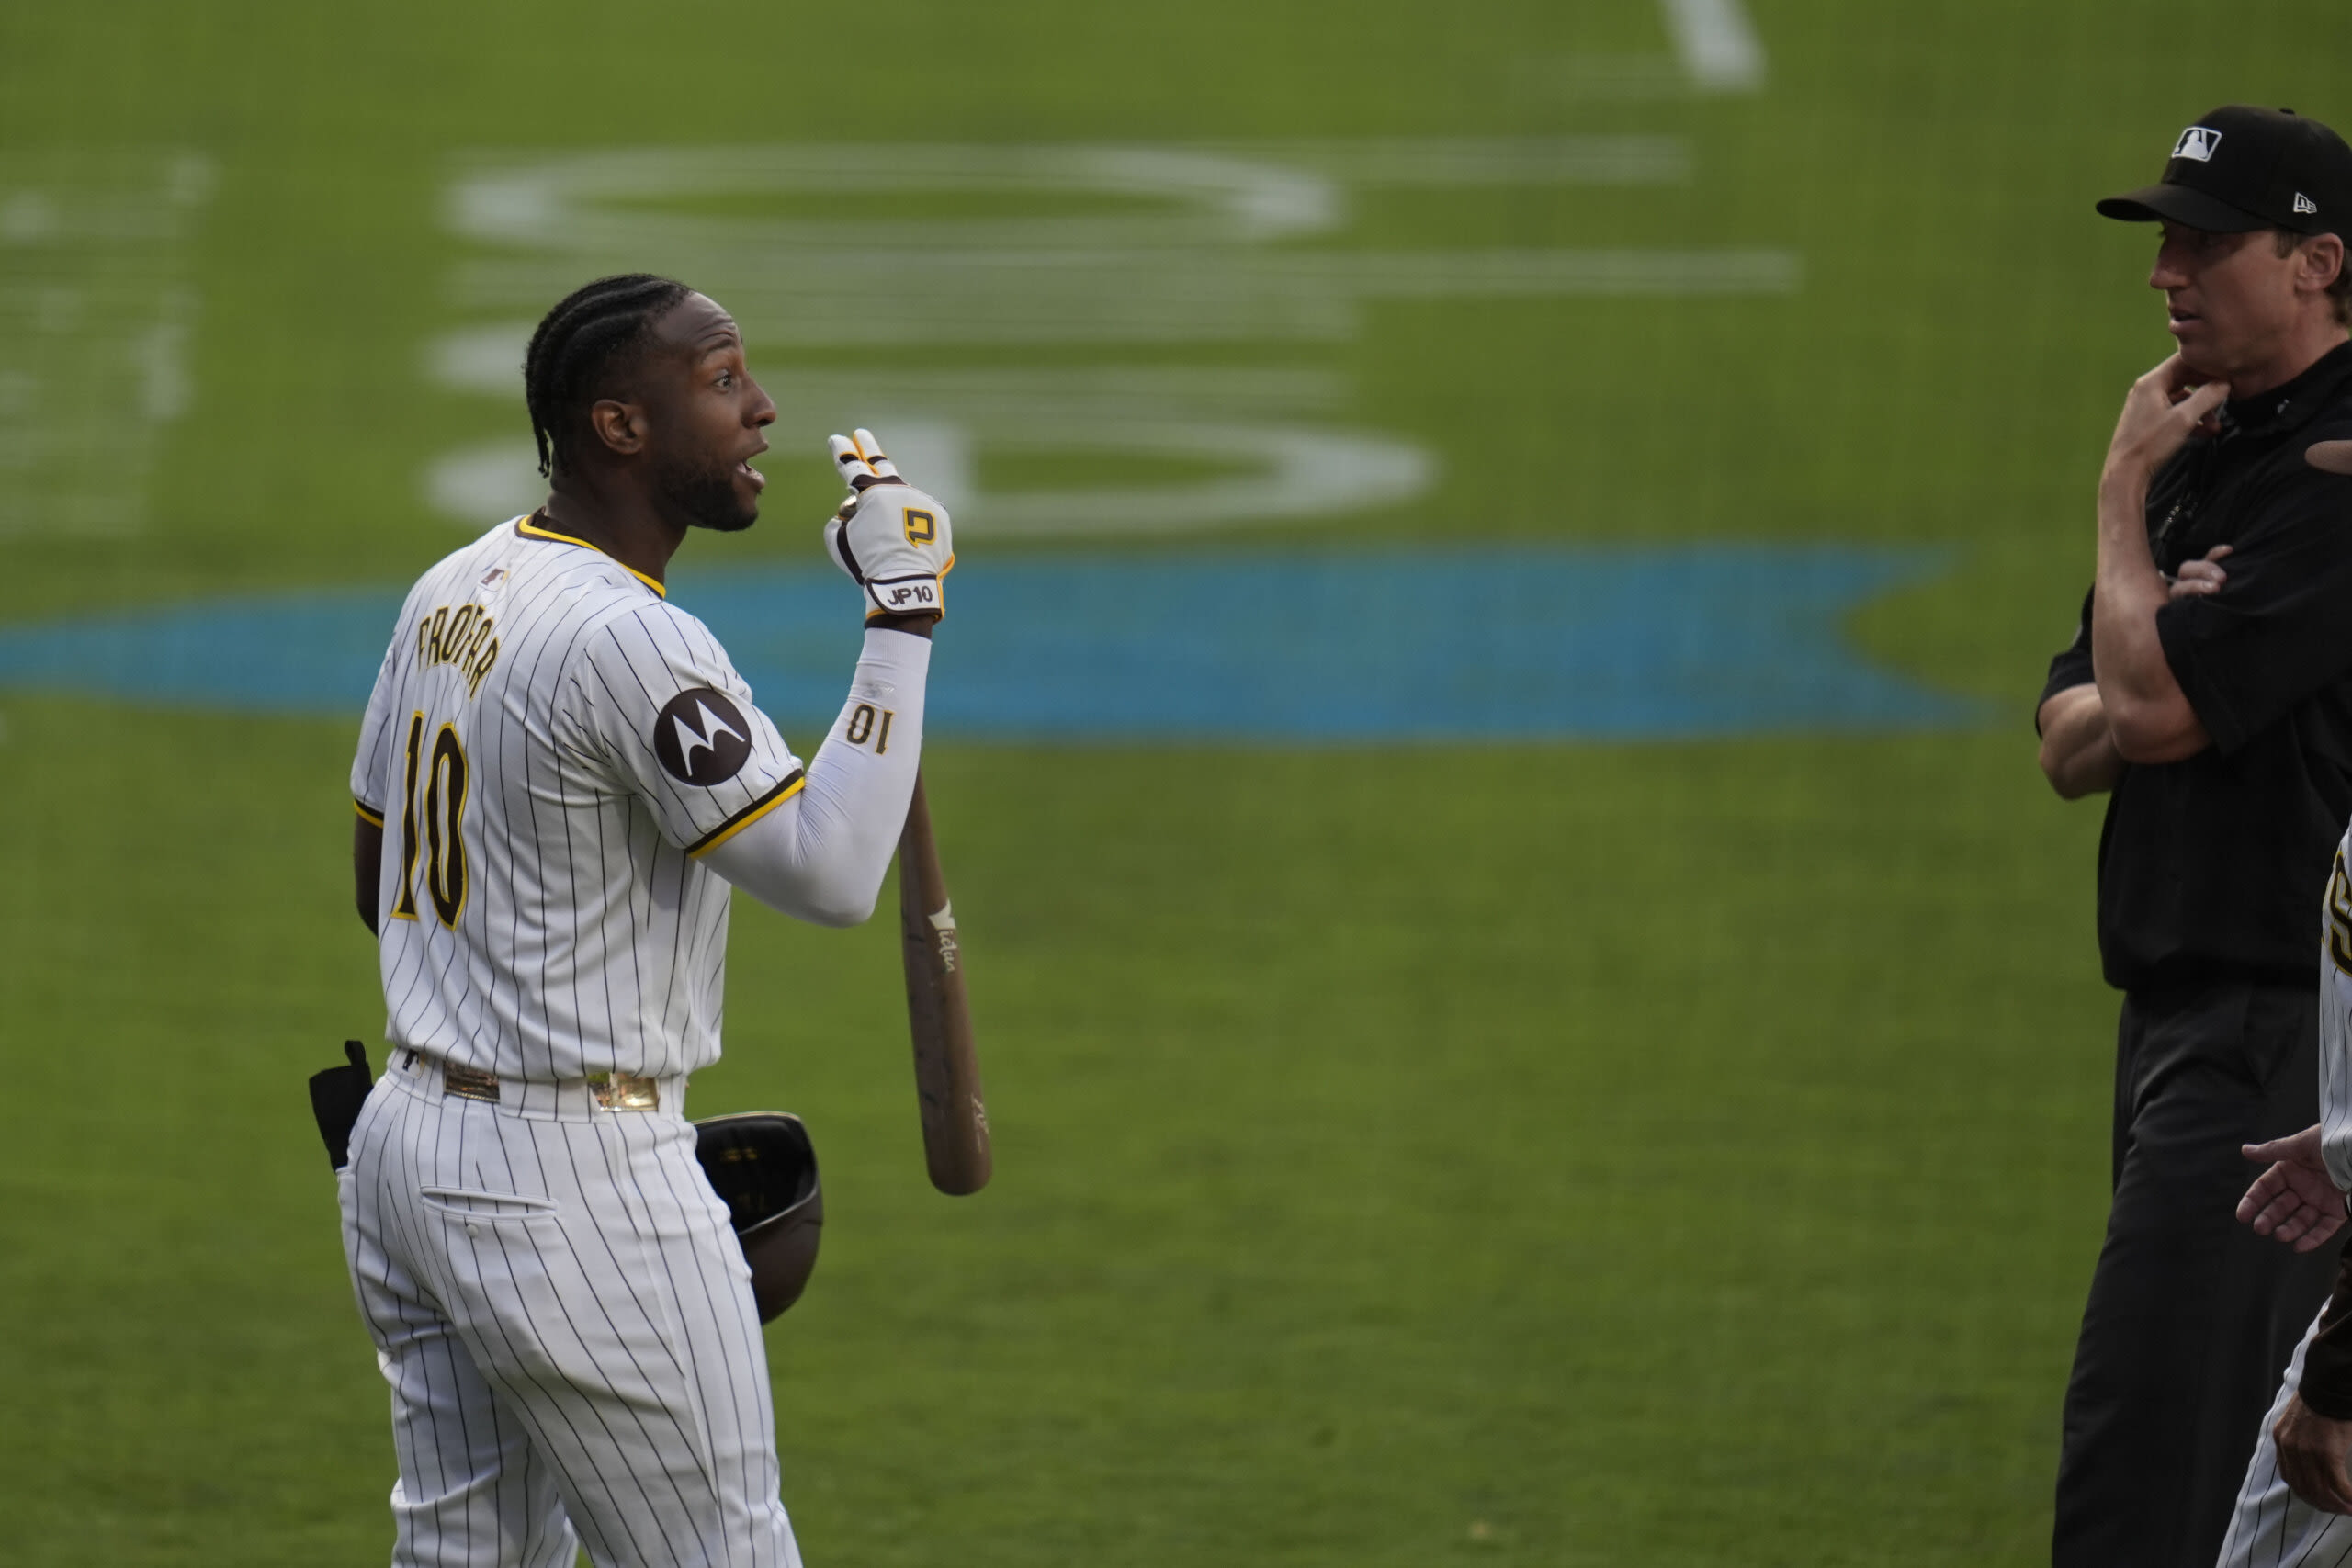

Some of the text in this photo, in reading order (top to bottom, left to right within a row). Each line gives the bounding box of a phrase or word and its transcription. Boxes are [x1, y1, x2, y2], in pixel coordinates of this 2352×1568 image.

[888, 585, 933, 605] JP10
[417, 603, 500, 702] PROFAR
[390, 710, 469, 931] 10
